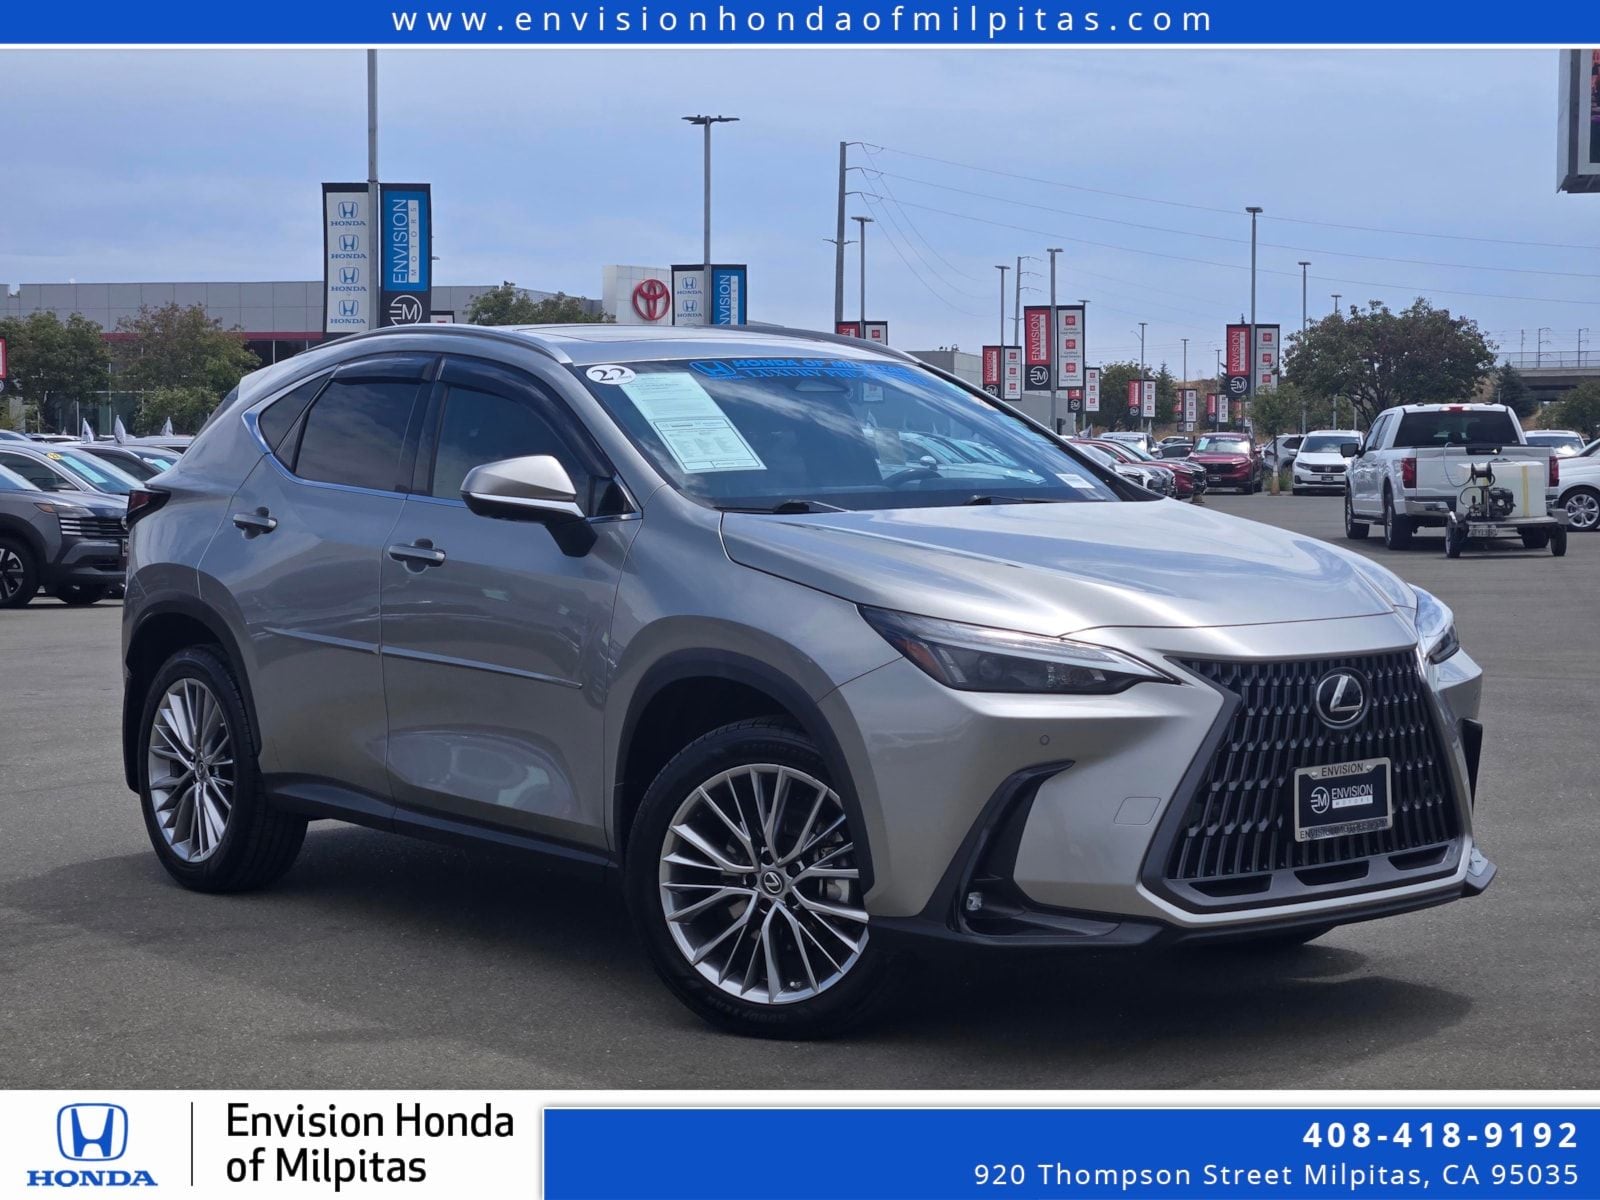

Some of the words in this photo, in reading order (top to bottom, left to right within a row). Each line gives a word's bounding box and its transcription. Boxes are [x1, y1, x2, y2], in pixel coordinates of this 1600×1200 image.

[393, 199, 407, 283] ENVISION
[719, 275, 730, 325] NVISION
[1031, 314, 1040, 360] ENVISION
[732, 359, 800, 368] HONDA
[1231, 331, 1240, 371] ENVISION
[591, 368, 632, 381] 22
[1322, 763, 1364, 777] ENVISION
[1331, 784, 1373, 799] ENVISION
